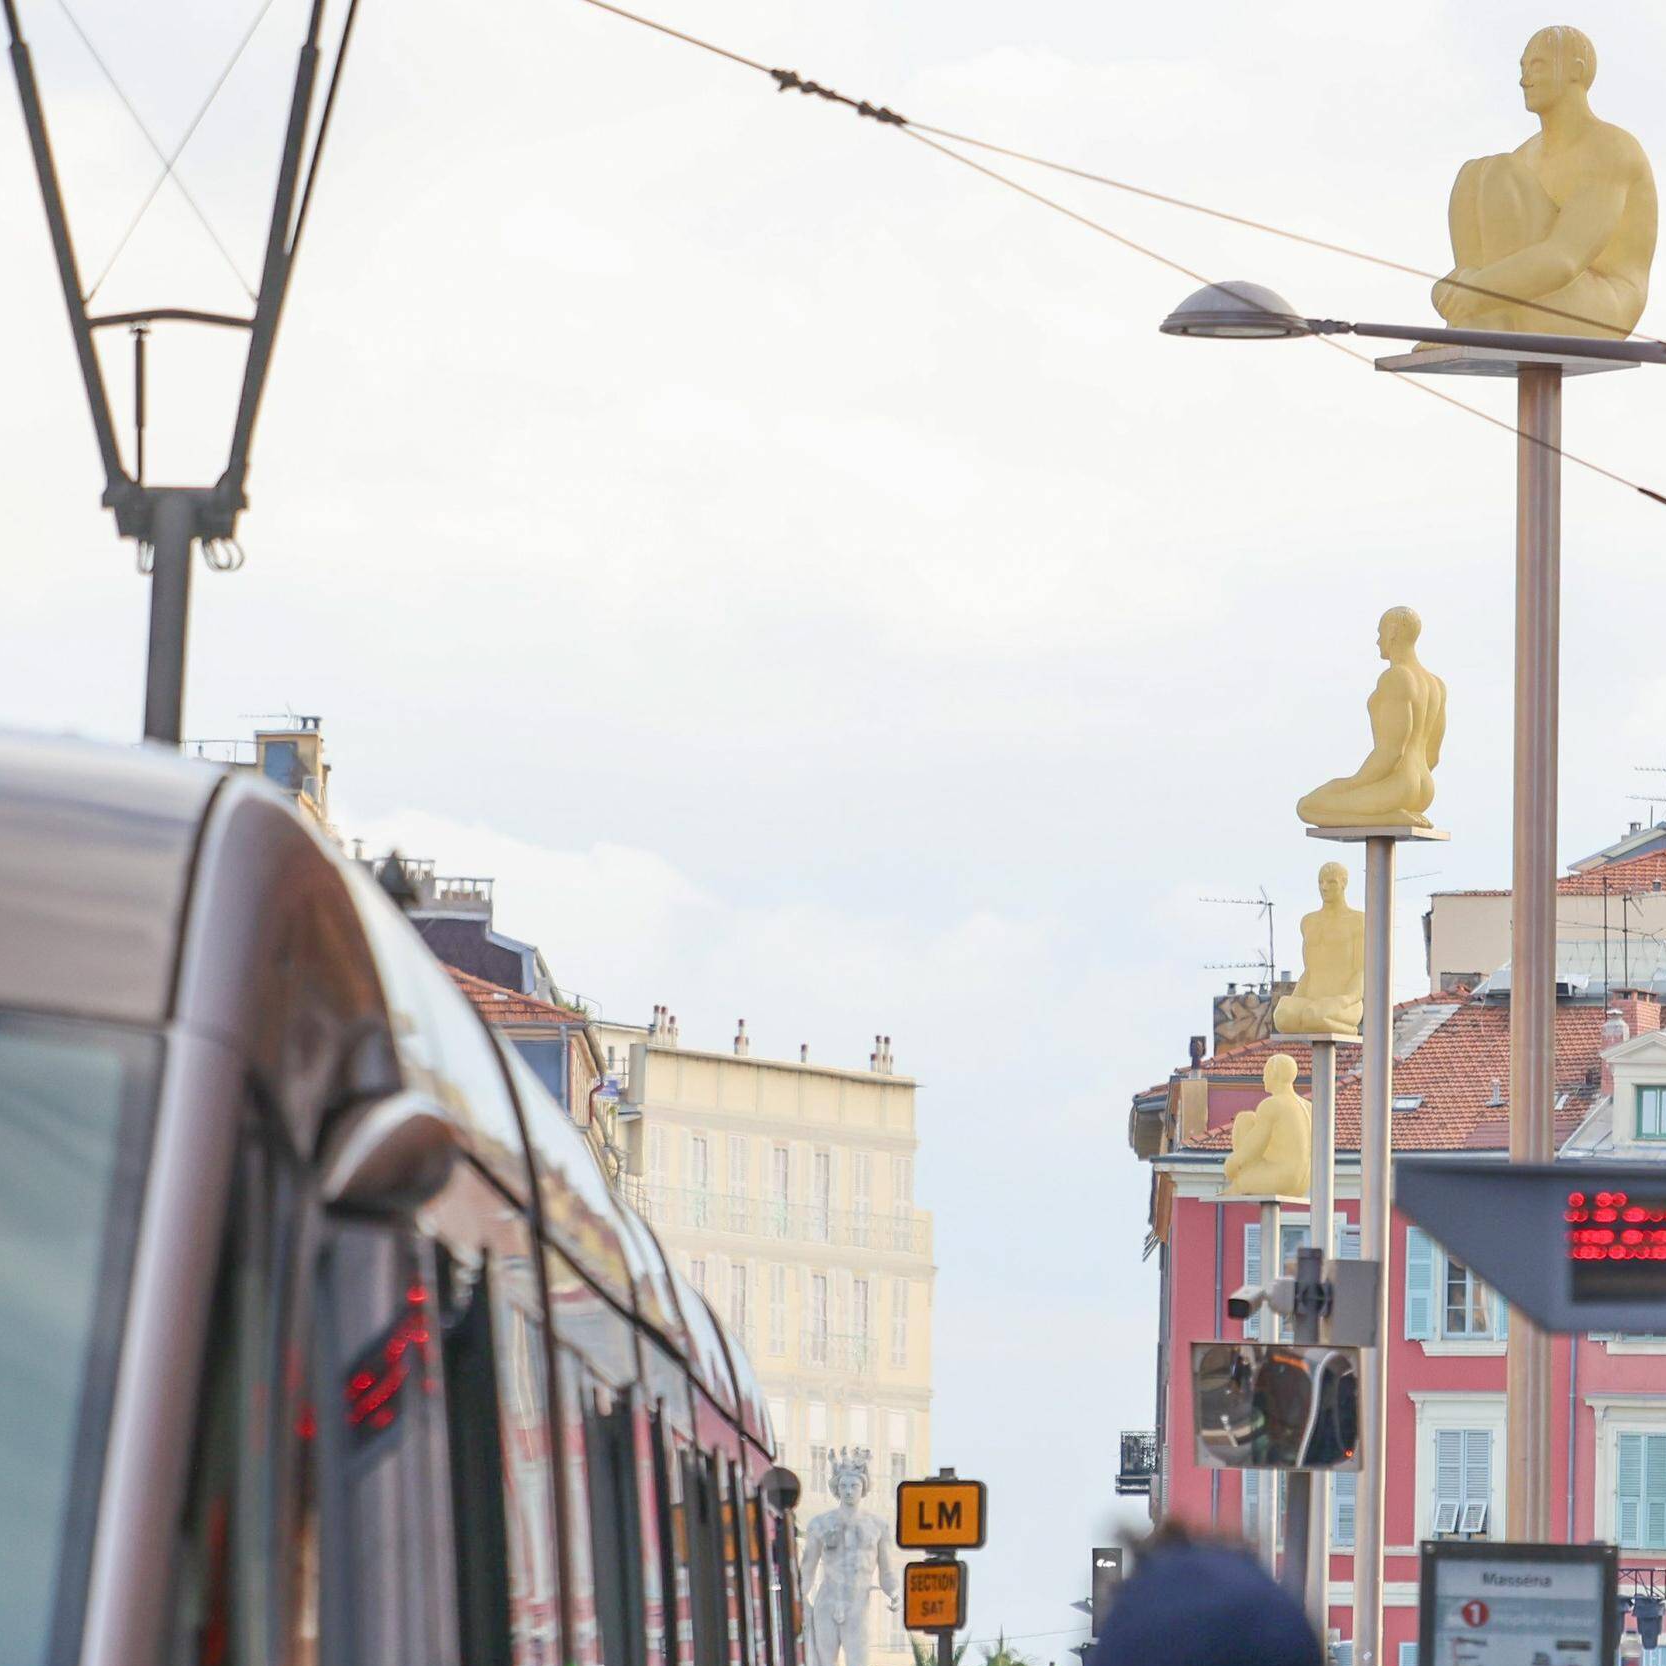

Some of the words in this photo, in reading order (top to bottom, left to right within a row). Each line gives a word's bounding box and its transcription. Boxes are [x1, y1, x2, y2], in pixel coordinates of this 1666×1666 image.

[918, 1500, 962, 1531] LM
[910, 1574, 957, 1592] SECTION
[921, 1600, 945, 1617] SAT
